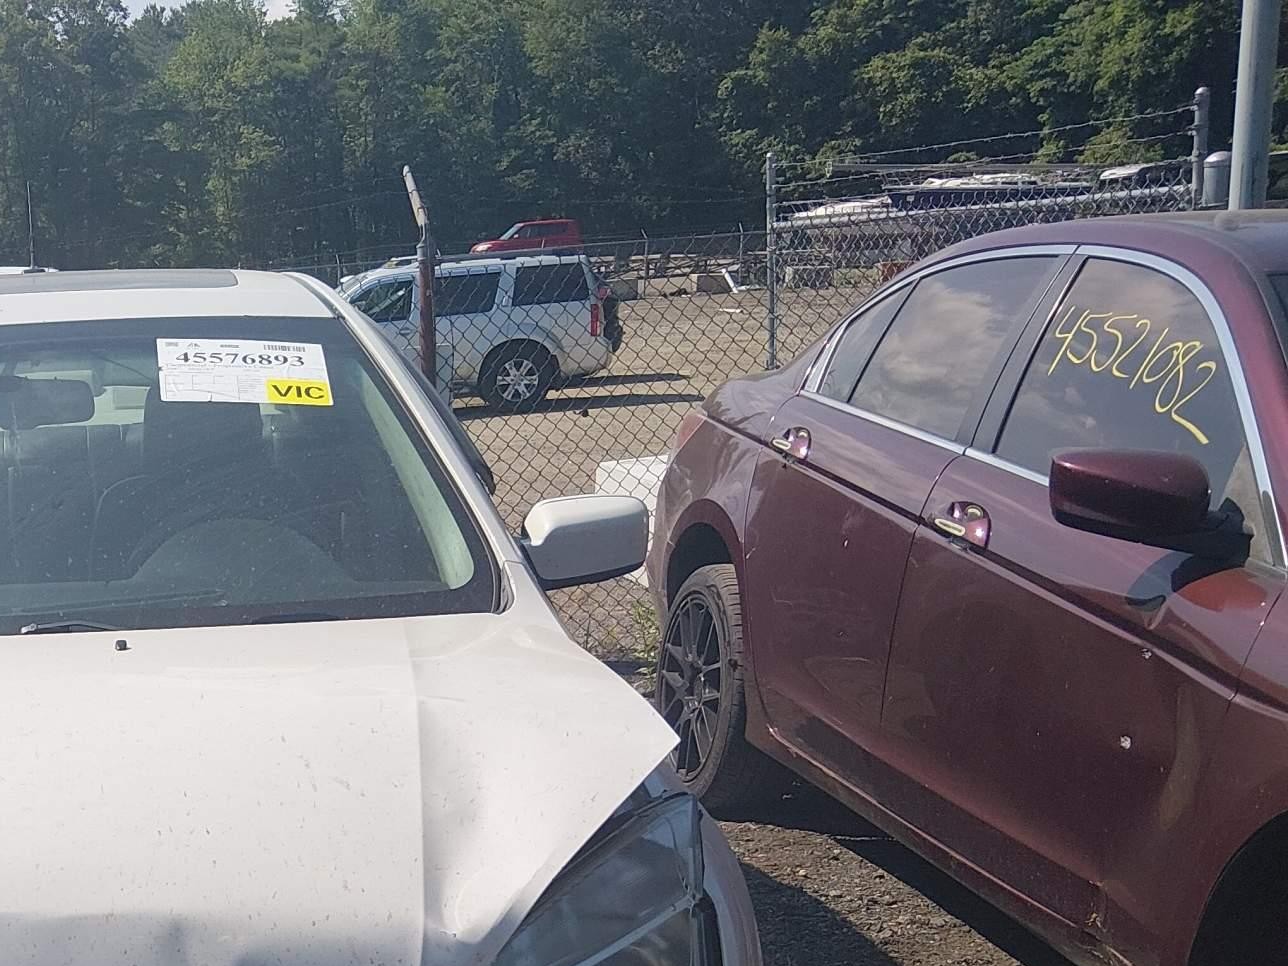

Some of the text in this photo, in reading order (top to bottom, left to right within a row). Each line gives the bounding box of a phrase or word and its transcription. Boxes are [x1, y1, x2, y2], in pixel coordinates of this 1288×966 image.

[175, 351, 305, 367] 45576893
[1047, 305, 1217, 445] 45521082
[271, 384, 325, 399] VIC
